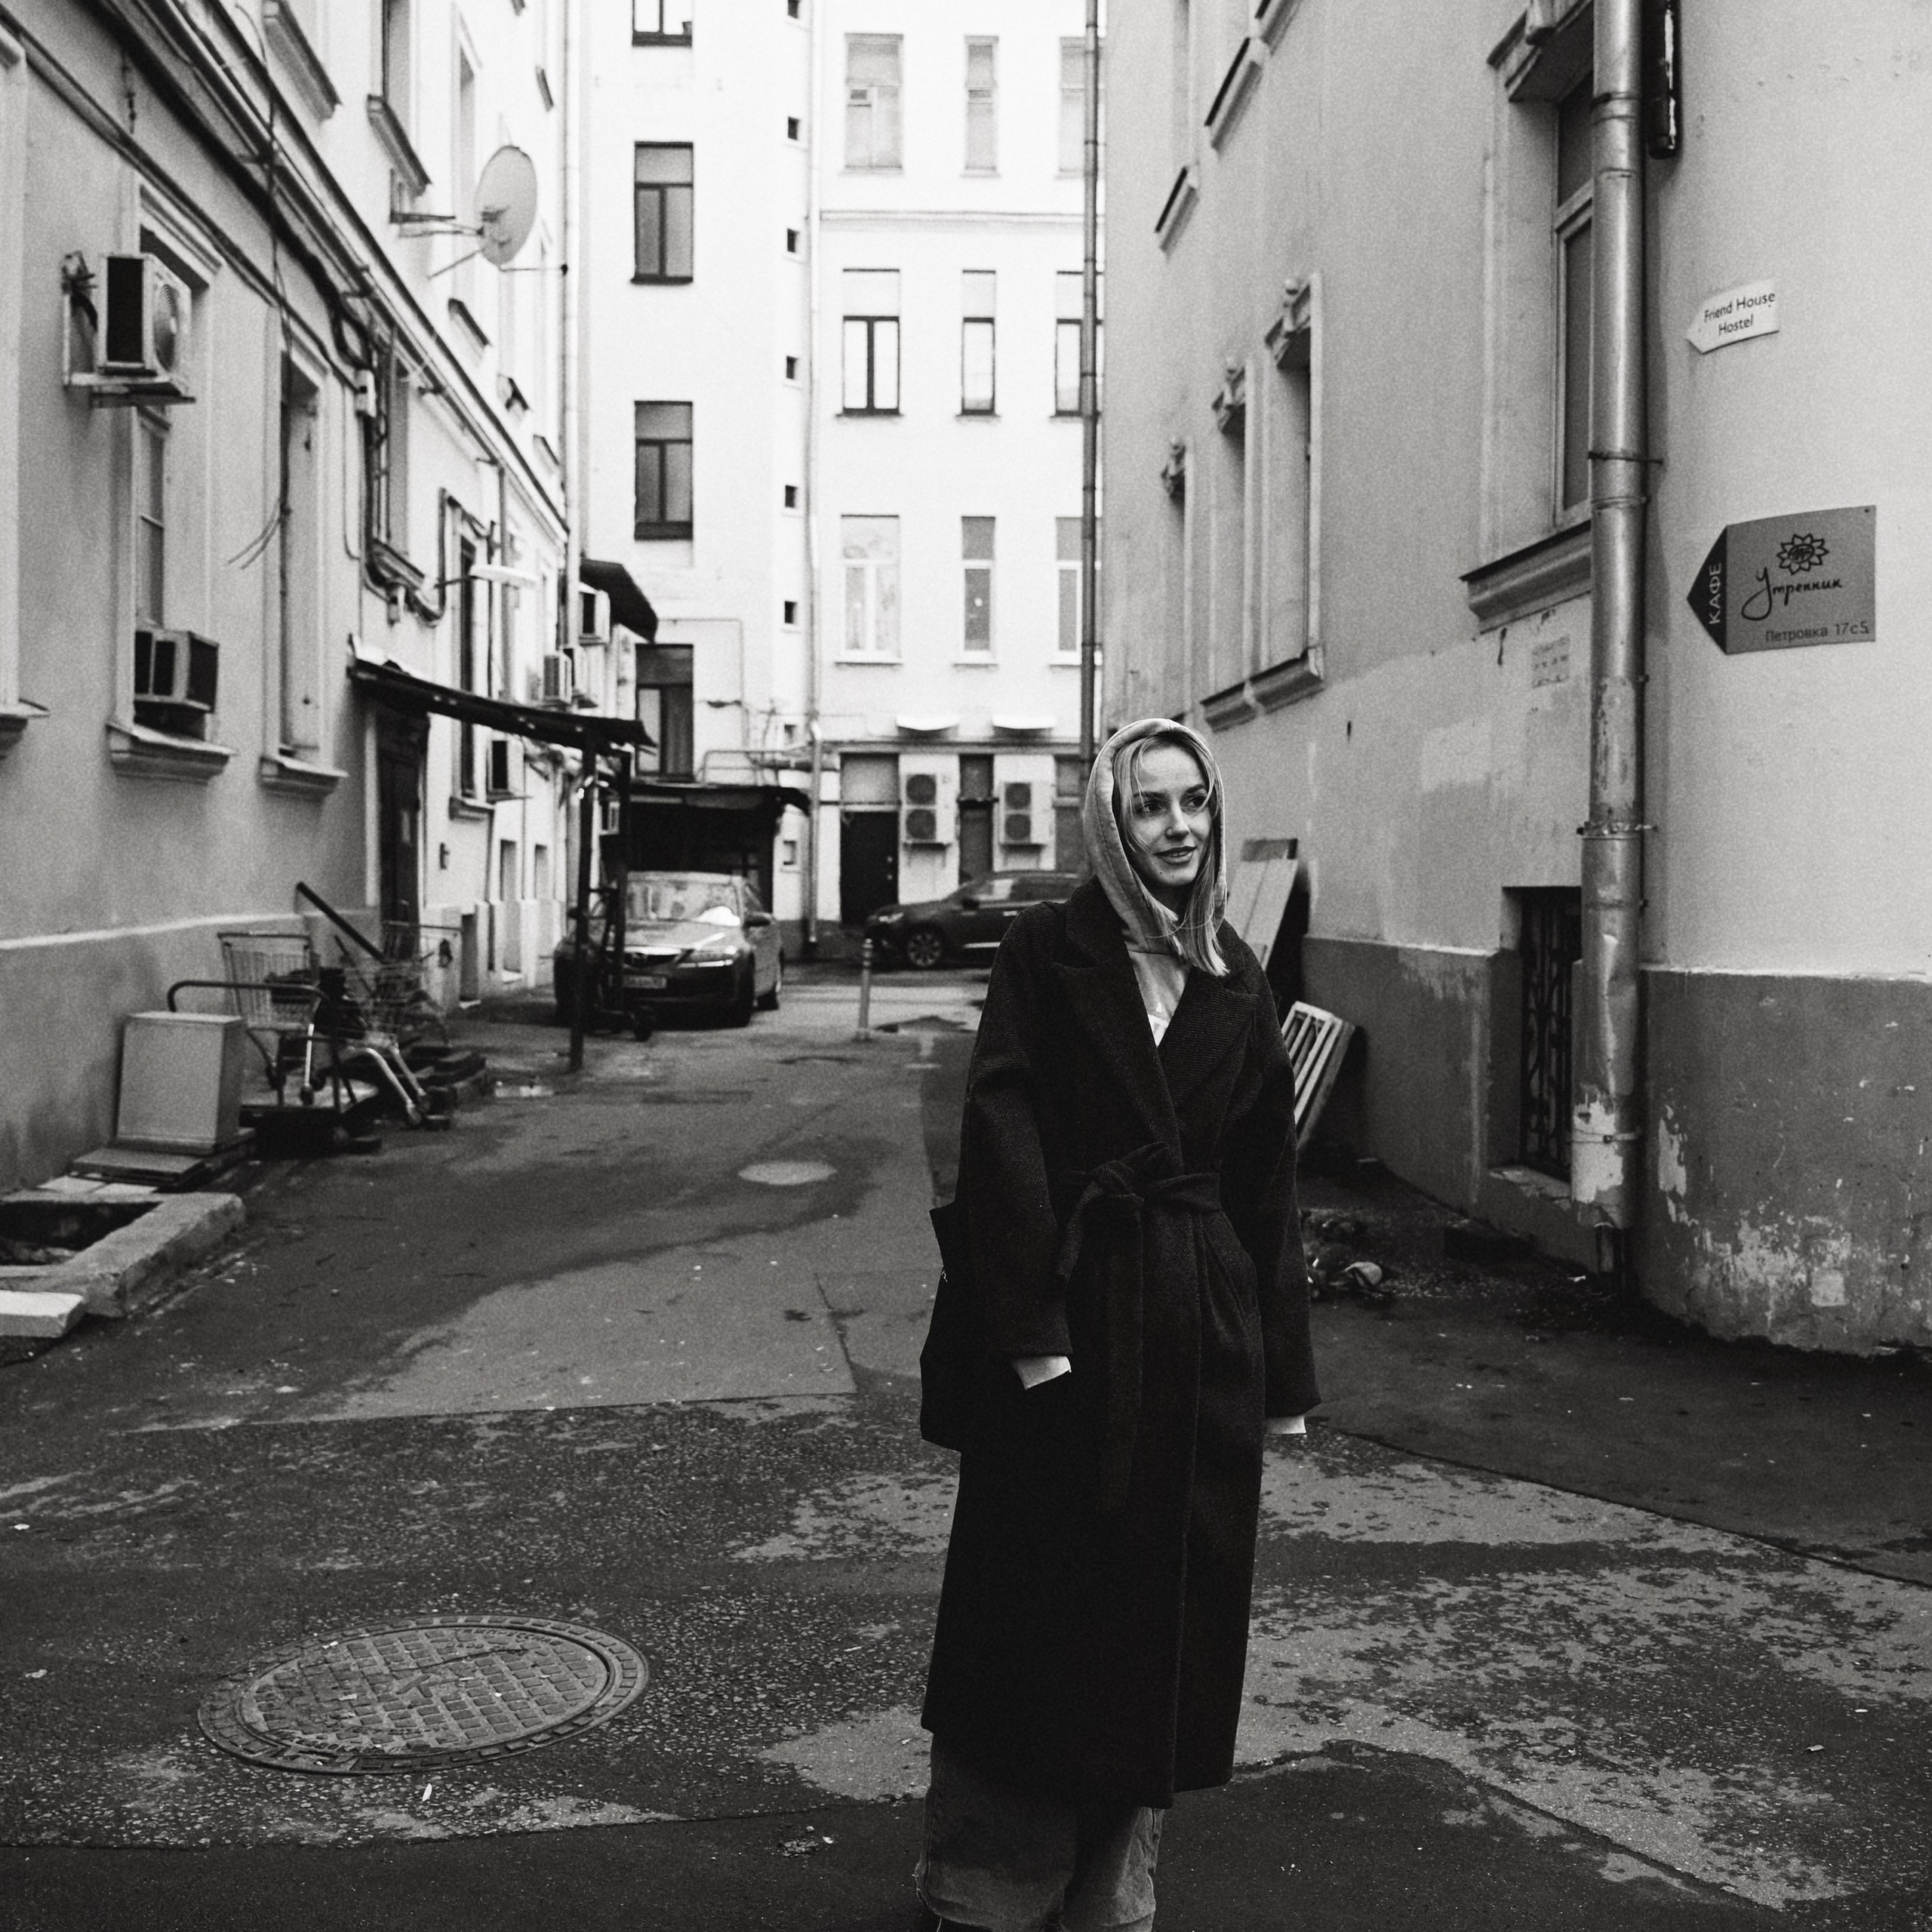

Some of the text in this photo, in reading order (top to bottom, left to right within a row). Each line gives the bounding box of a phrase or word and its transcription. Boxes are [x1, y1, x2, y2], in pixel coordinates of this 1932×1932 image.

[1704, 293, 1775, 323] Friend House
[1718, 314, 1754, 336] Hostel
[1709, 562, 1722, 625] КАФЕ
[1741, 567, 1843, 621] Утренник
[1765, 627, 1828, 643] Петровка
